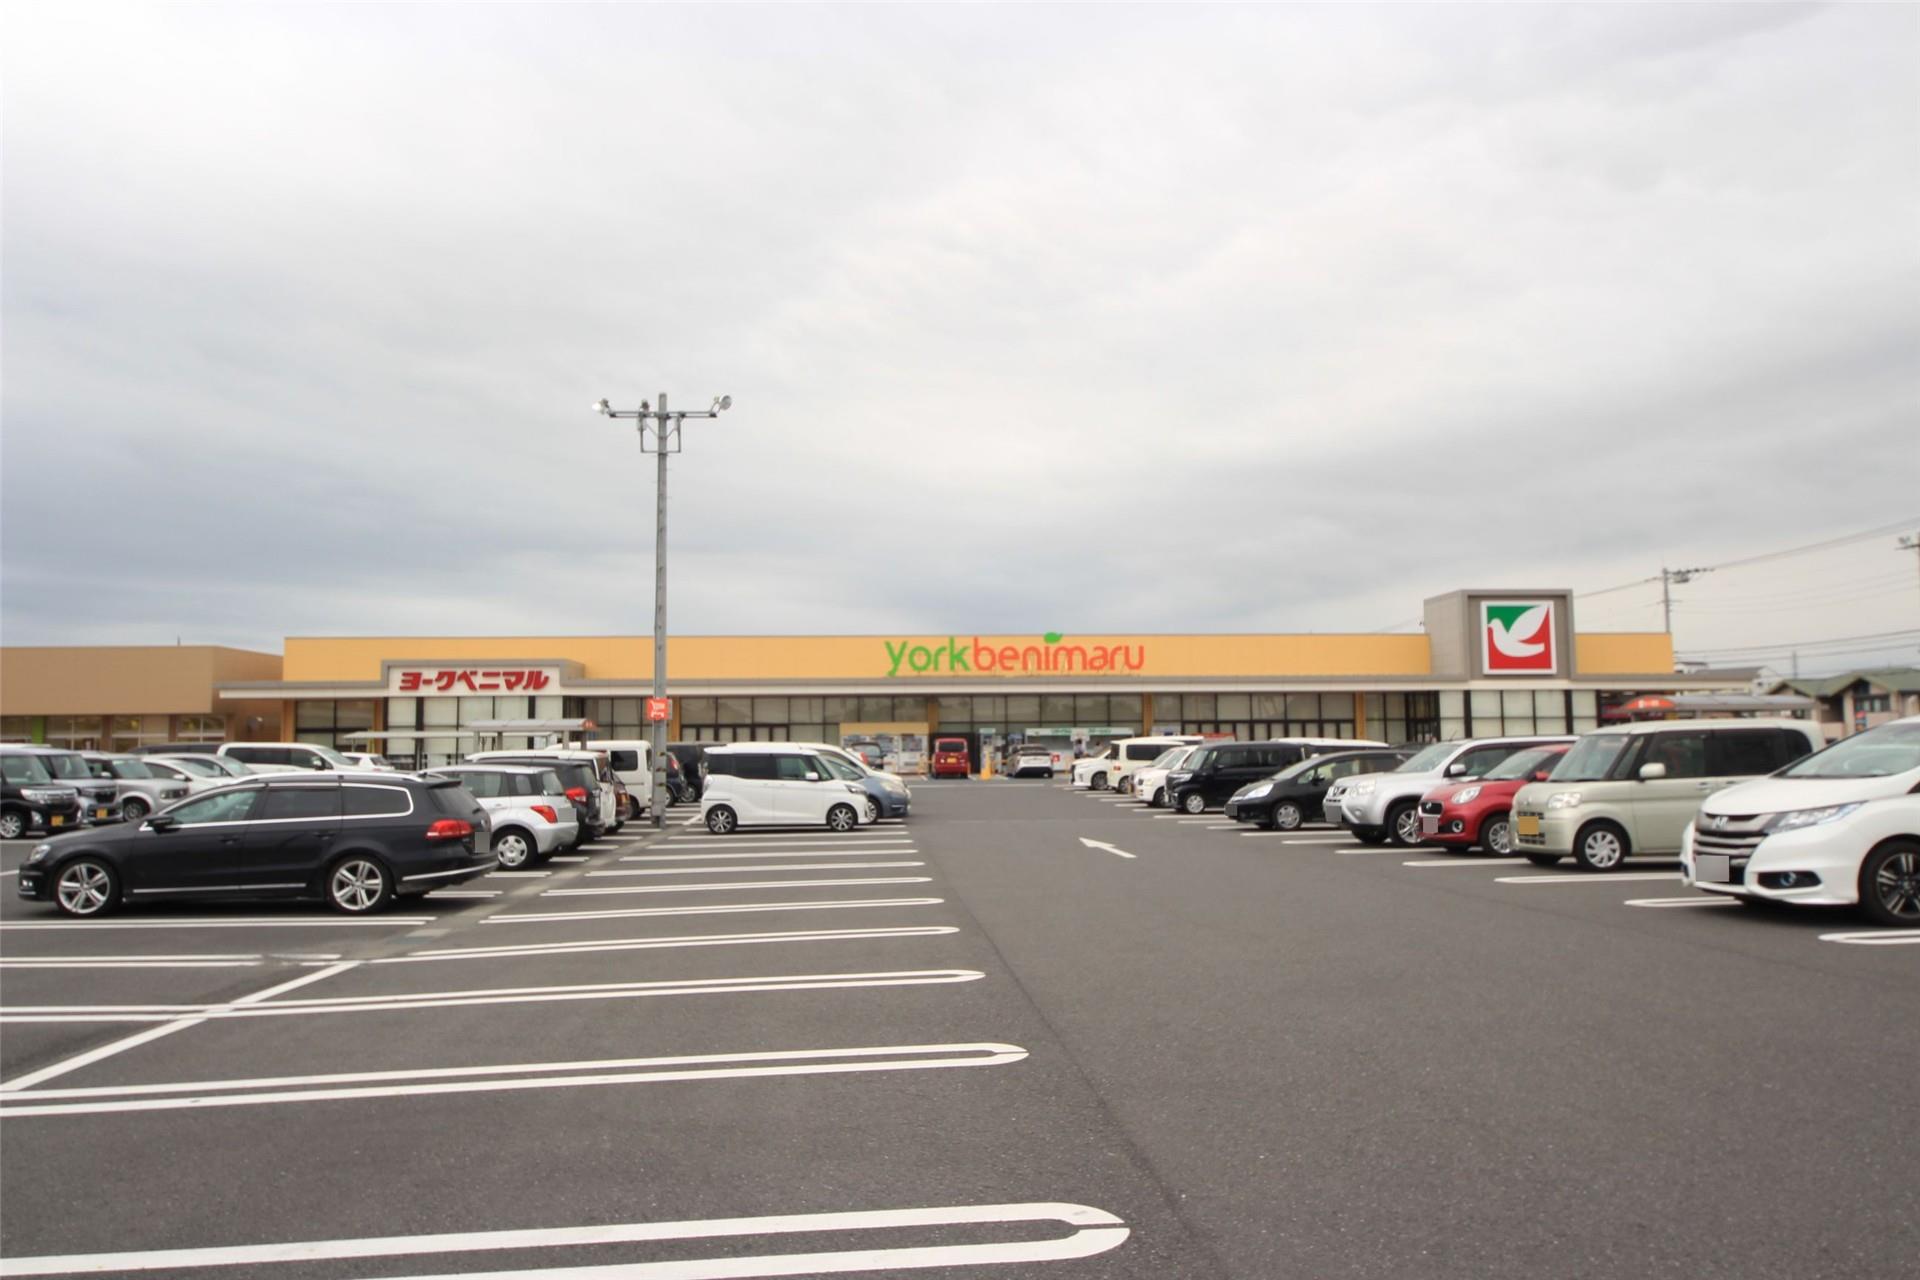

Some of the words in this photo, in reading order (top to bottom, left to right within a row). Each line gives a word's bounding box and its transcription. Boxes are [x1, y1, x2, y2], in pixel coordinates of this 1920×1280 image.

[884, 634, 1145, 676] yorkbenimaru
[399, 670, 550, 691] ヨークベニマル
